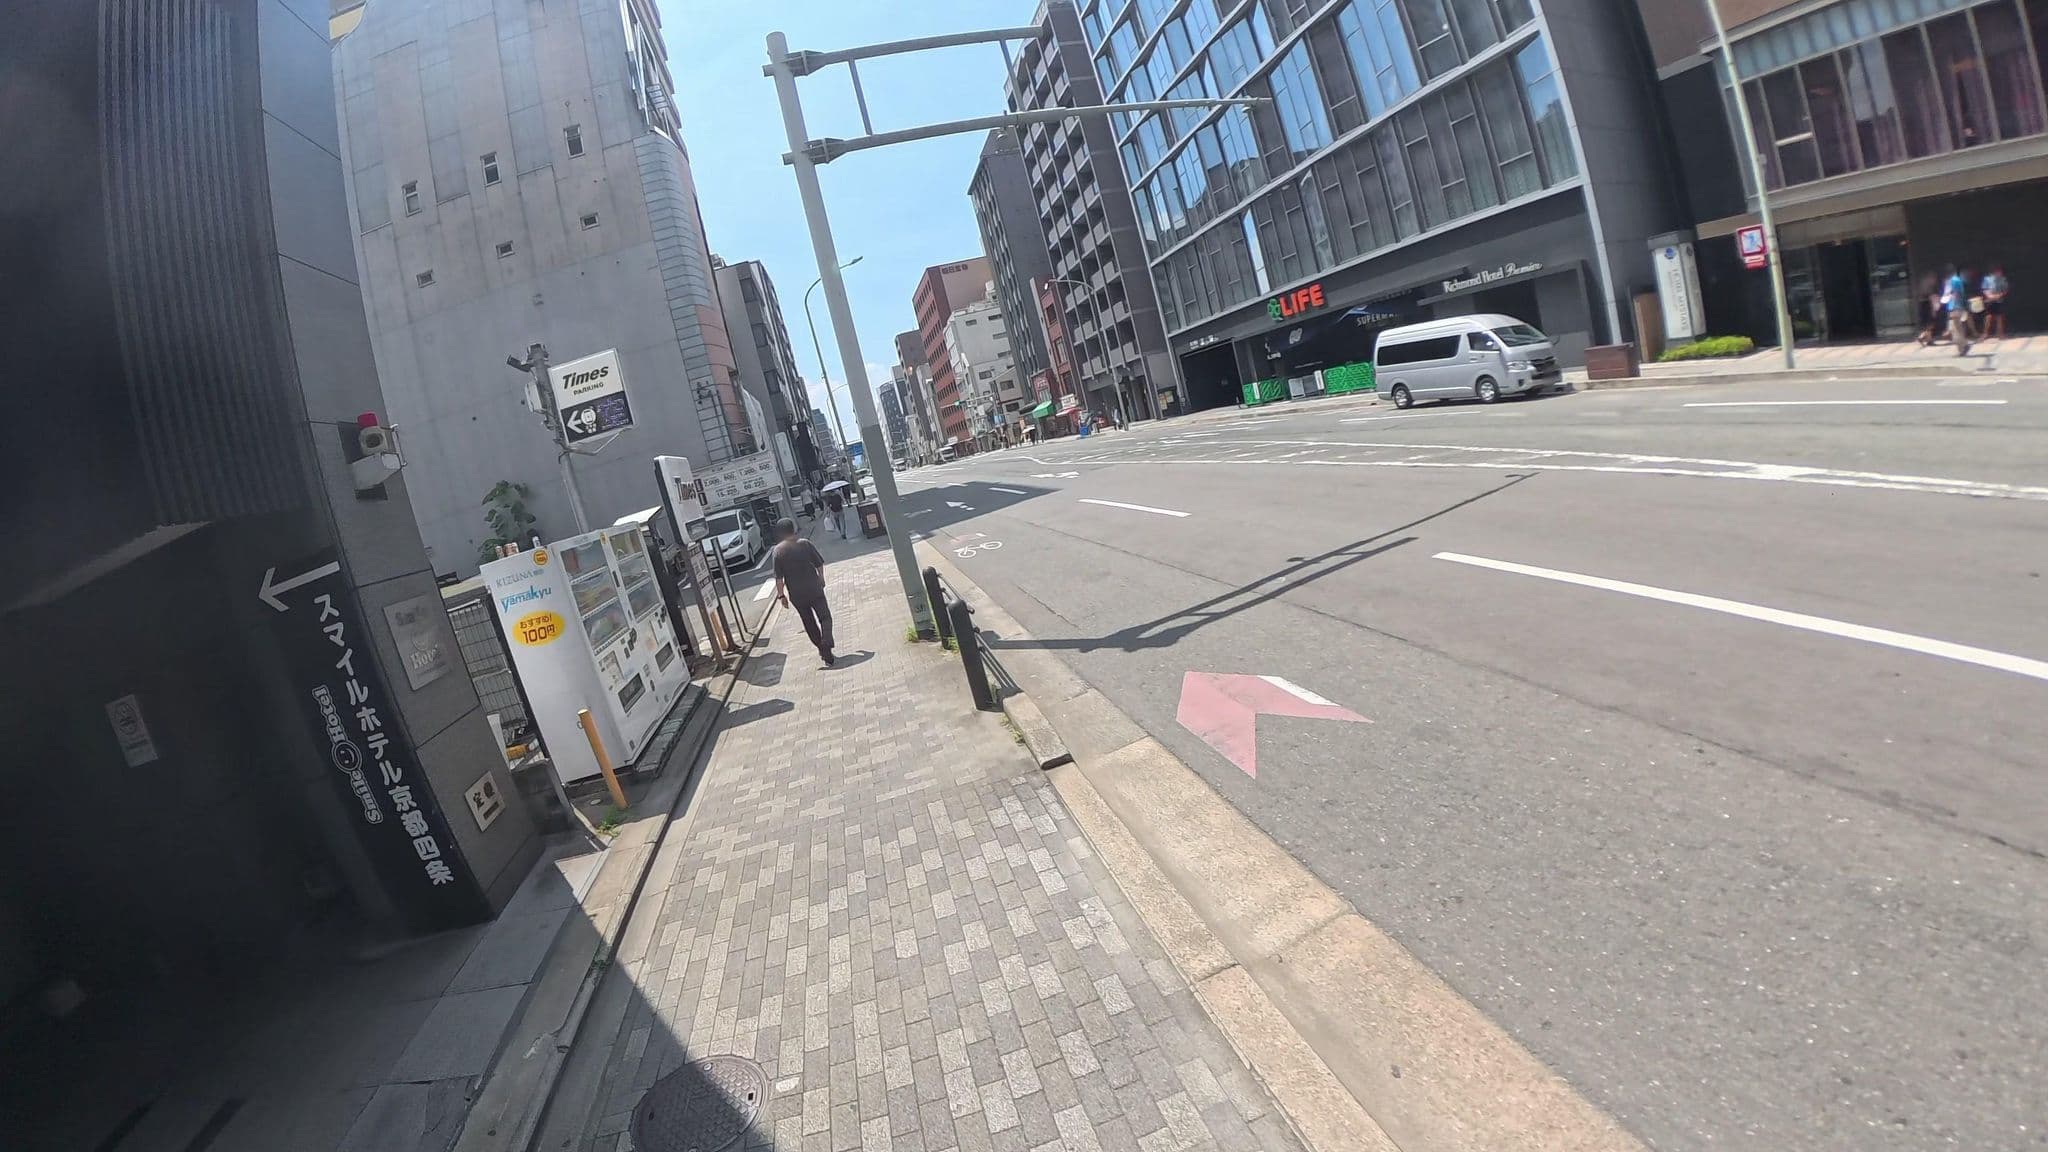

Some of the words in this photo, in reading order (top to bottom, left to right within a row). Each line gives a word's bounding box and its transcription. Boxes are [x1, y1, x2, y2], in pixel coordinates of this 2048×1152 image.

[1443, 272, 1482, 293] Richmond
[1481, 267, 1504, 284] Hotel
[1280, 283, 1325, 317] LIFE
[562, 365, 609, 389] Times
[573, 382, 604, 396] PARKING
[501, 585, 551, 613] yamakyu
[523, 623, 555, 643] 100円
[313, 685, 347, 743] Hotel
[314, 594, 454, 886] スマイルホテル京都四条
[351, 769, 382, 823] Smile
